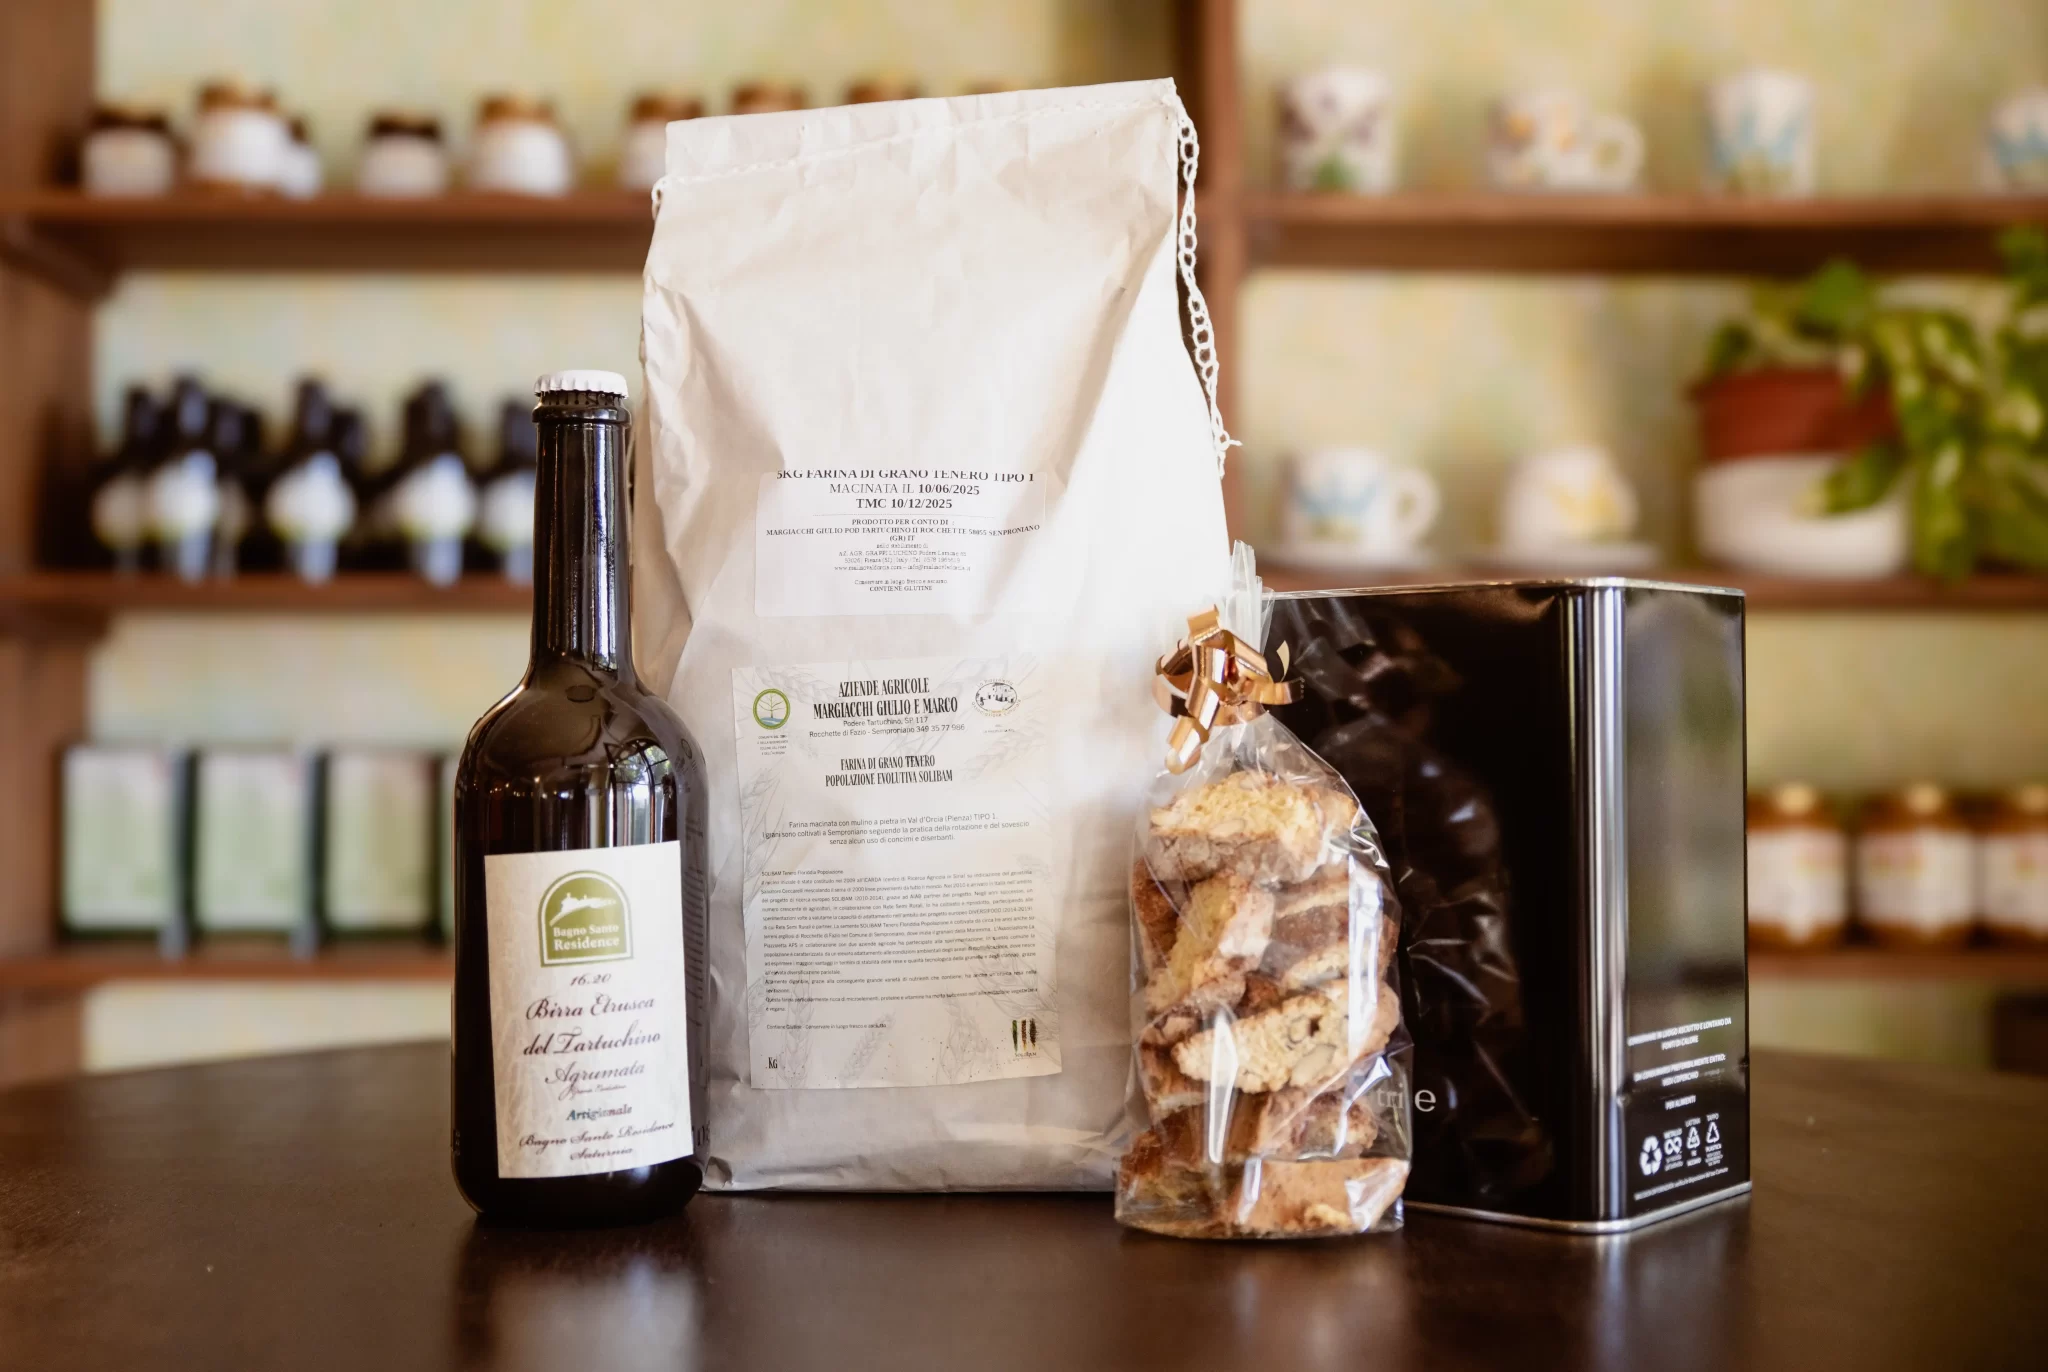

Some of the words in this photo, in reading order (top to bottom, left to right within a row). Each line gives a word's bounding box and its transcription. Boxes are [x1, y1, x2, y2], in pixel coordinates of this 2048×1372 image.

[776, 469, 803, 480] 5KG
[806, 469, 858, 480] FARINA
[860, 469, 875, 480] DI
[878, 469, 929, 480] GRANO
[932, 470, 989, 482] TENERO
[993, 472, 1025, 483] TIPO
[1028, 473, 1034, 482] 1
[829, 483, 898, 494] MACINATA
[902, 483, 914, 494] IL
[918, 484, 980, 496] 10/06/2025
[856, 498, 887, 509] TMC
[891, 498, 953, 509] 10/12/2025
[766, 528, 814, 536] MARGIACCHI
[920, 527, 967, 535] ROCCHETTE
[988, 524, 1040, 537] SENPRONIANO
[838, 679, 879, 698] AZIENDE
[881, 677, 930, 696] AGRICOLE
[813, 701, 873, 719] MARGIACCHI
[876, 699, 911, 717] GIULIO
[914, 698, 920, 715] E
[922, 696, 958, 714] MARCO
[809, 730, 841, 738] Rocchette
[849, 728, 866, 736] Fazio
[871, 726, 915, 736] Semproniano
[916, 725, 929, 733] 349
[941, 724, 950, 732] 77
[843, 719, 866, 727] Podere
[840, 757, 866, 771] FARINA
[867, 757, 876, 770] DI
[878, 756, 903, 769] GRANO
[904, 754, 935, 768] TENERO
[825, 772, 876, 787] POPOLAZIONE
[877, 771, 917, 785] EVOLUTIVA
[918, 769, 953, 783] SOLIBAM
[788, 821, 809, 829] Farina
[809, 820, 838, 828] macinata
[851, 819, 873, 827] mulino
[879, 818, 899, 826] pietra
[944, 814, 972, 823] (Pienza)
[973, 813, 991, 821] TIPO
[797, 829, 822, 837] coltivati
[827, 828, 868, 838] Semproniano
[868, 827, 901, 836] seguendo
[909, 825, 933, 834] pratica
[951, 823, 983, 831] rotazione
[1001, 820, 1030, 828] sovescio
[848, 837, 866, 845] alcun
[887, 835, 914, 843] concimi
[553, 926, 587, 939] Bagno
[588, 923, 620, 935] Santo
[553, 936, 620, 952] Residence
[570, 972, 612, 987] 16.20
[525, 995, 584, 1021] Birra
[589, 992, 656, 1017] Etrusca
[523, 1033, 555, 1056] del
[553, 1019, 661, 1054] Tartuchino
[544, 1060, 645, 1101] Agrumata
[519, 1132, 567, 1155] Bagno
[570, 1129, 614, 1145] Santo
[617, 1120, 675, 1139] Residence
